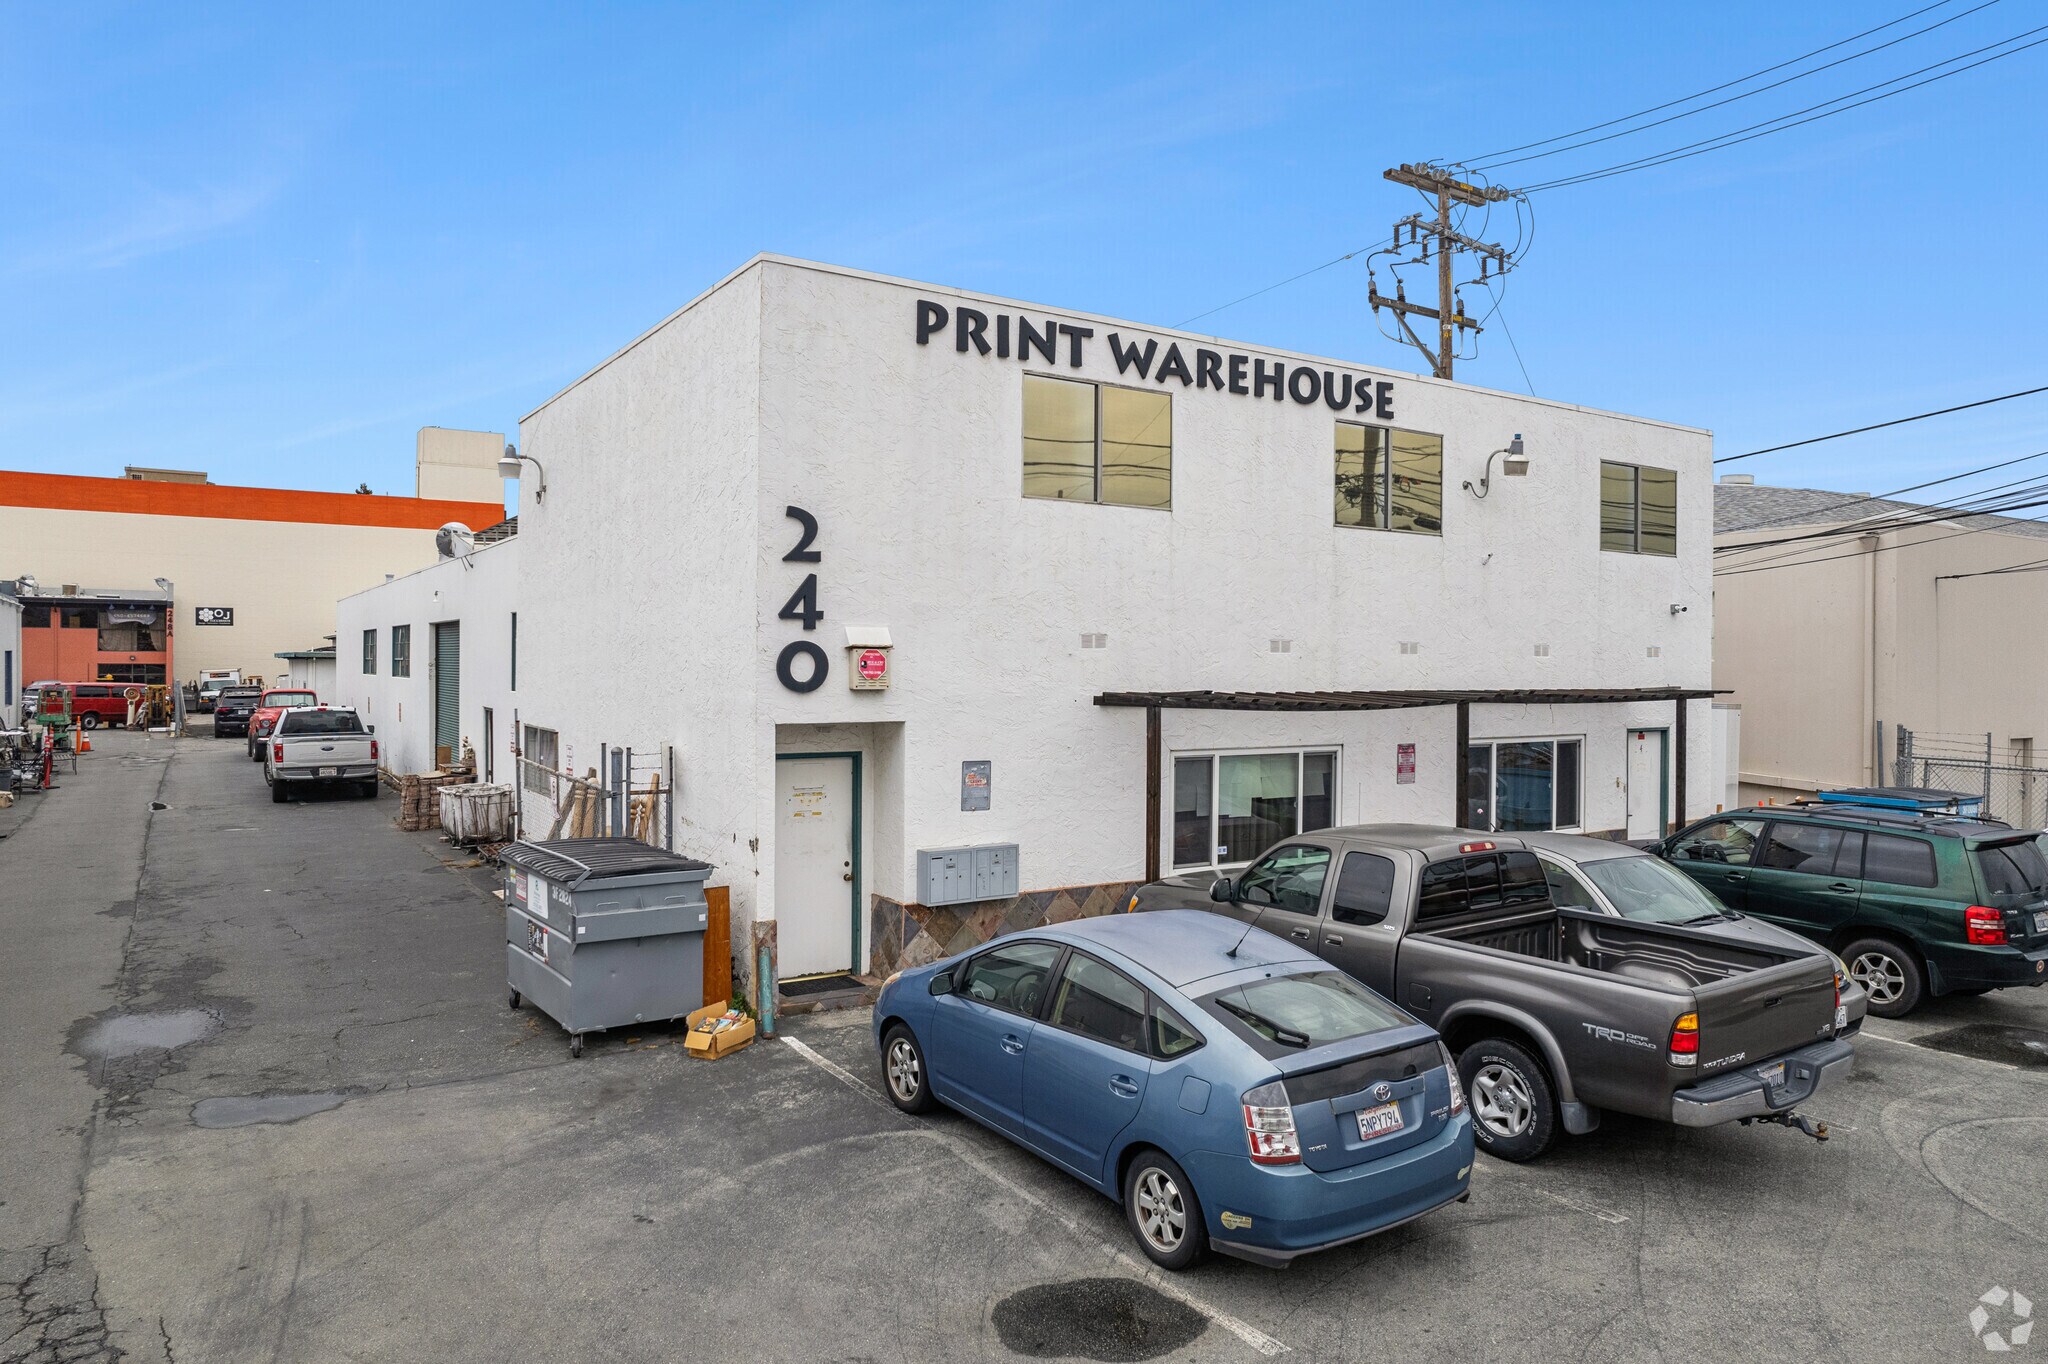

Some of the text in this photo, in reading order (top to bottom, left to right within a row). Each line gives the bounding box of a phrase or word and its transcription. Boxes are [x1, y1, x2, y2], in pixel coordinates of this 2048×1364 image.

[916, 299, 1395, 420] PRINT WAREHOUSE
[776, 505, 829, 693] 240
[214, 608, 231, 620] OJ
[166, 610, 174, 637] 248A
[1582, 1022, 1649, 1041] TRD OFF
[1626, 1038, 1657, 1049] ROAD
[1717, 1052, 1746, 1067] TUNDRA
[1308, 1143, 1328, 1152] TOYOTA
